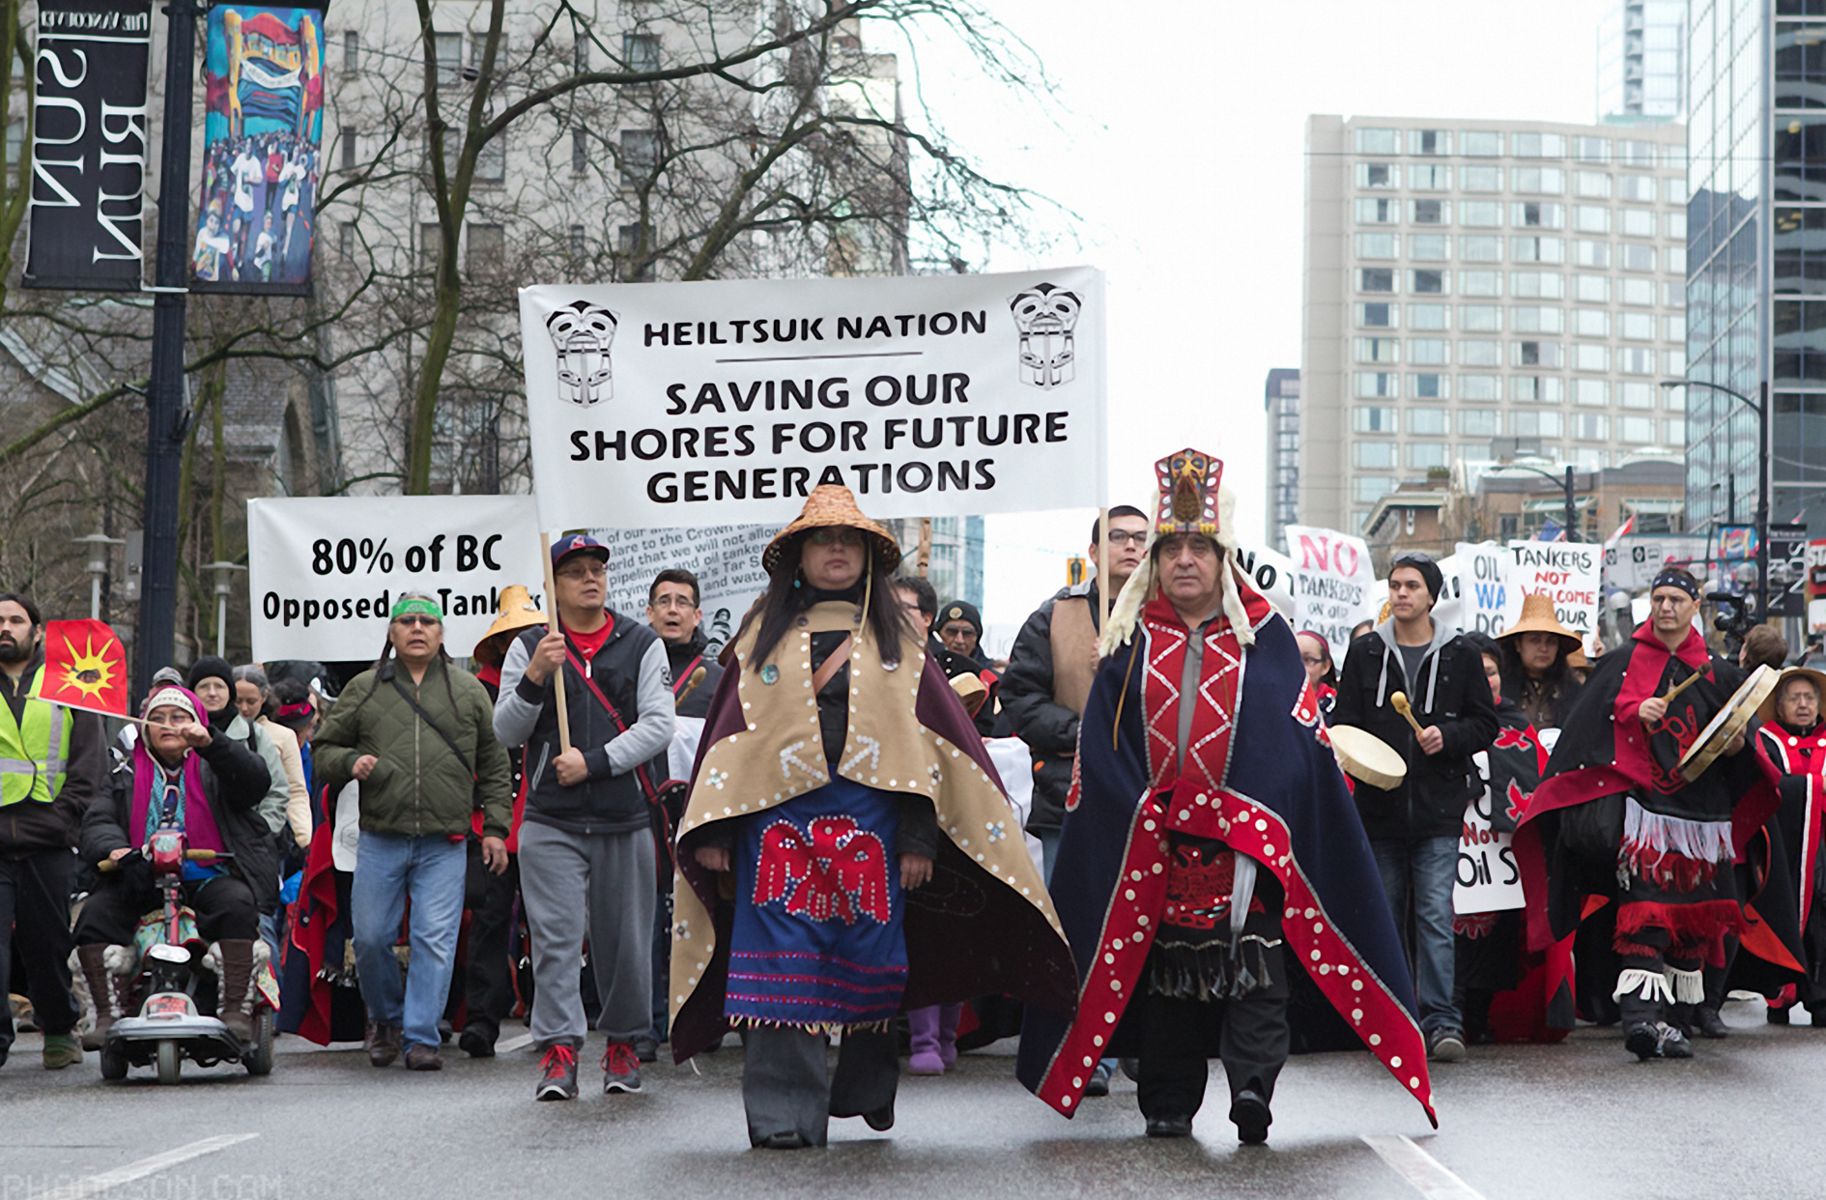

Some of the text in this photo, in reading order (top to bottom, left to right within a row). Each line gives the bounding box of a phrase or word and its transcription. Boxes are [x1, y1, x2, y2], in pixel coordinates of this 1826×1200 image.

[644, 310, 986, 347] HEILTSUK NATION
[666, 372, 970, 416] SAVING OUR
[570, 411, 1069, 462] SHORES FOR FUTURE
[647, 458, 997, 503] GENERATIONS
[608, 530, 620, 544] of
[642, 540, 656, 551] to
[660, 533, 683, 546] the
[687, 525, 733, 541] Crown
[312, 533, 503, 576] 80% of BC
[609, 557, 635, 571] orld
[638, 550, 668, 565] that
[671, 547, 691, 558] we
[695, 538, 719, 553] will
[722, 535, 746, 547] not
[704, 552, 719, 565] oil
[723, 543, 768, 560] tanker
[723, 561, 746, 573] Tar
[1299, 534, 1359, 577] NO
[1511, 546, 1592, 575] TANKERS
[704, 575, 728, 591] and
[731, 571, 767, 585] wate
[1474, 555, 1500, 582] OIL
[1535, 571, 1571, 585] NOT
[1299, 574, 1363, 606] TANKERS
[1475, 583, 1506, 610] WA
[263, 586, 541, 628] Opposed Tanks
[1556, 607, 1590, 629] OUR
[1456, 847, 1520, 888] Oil S
